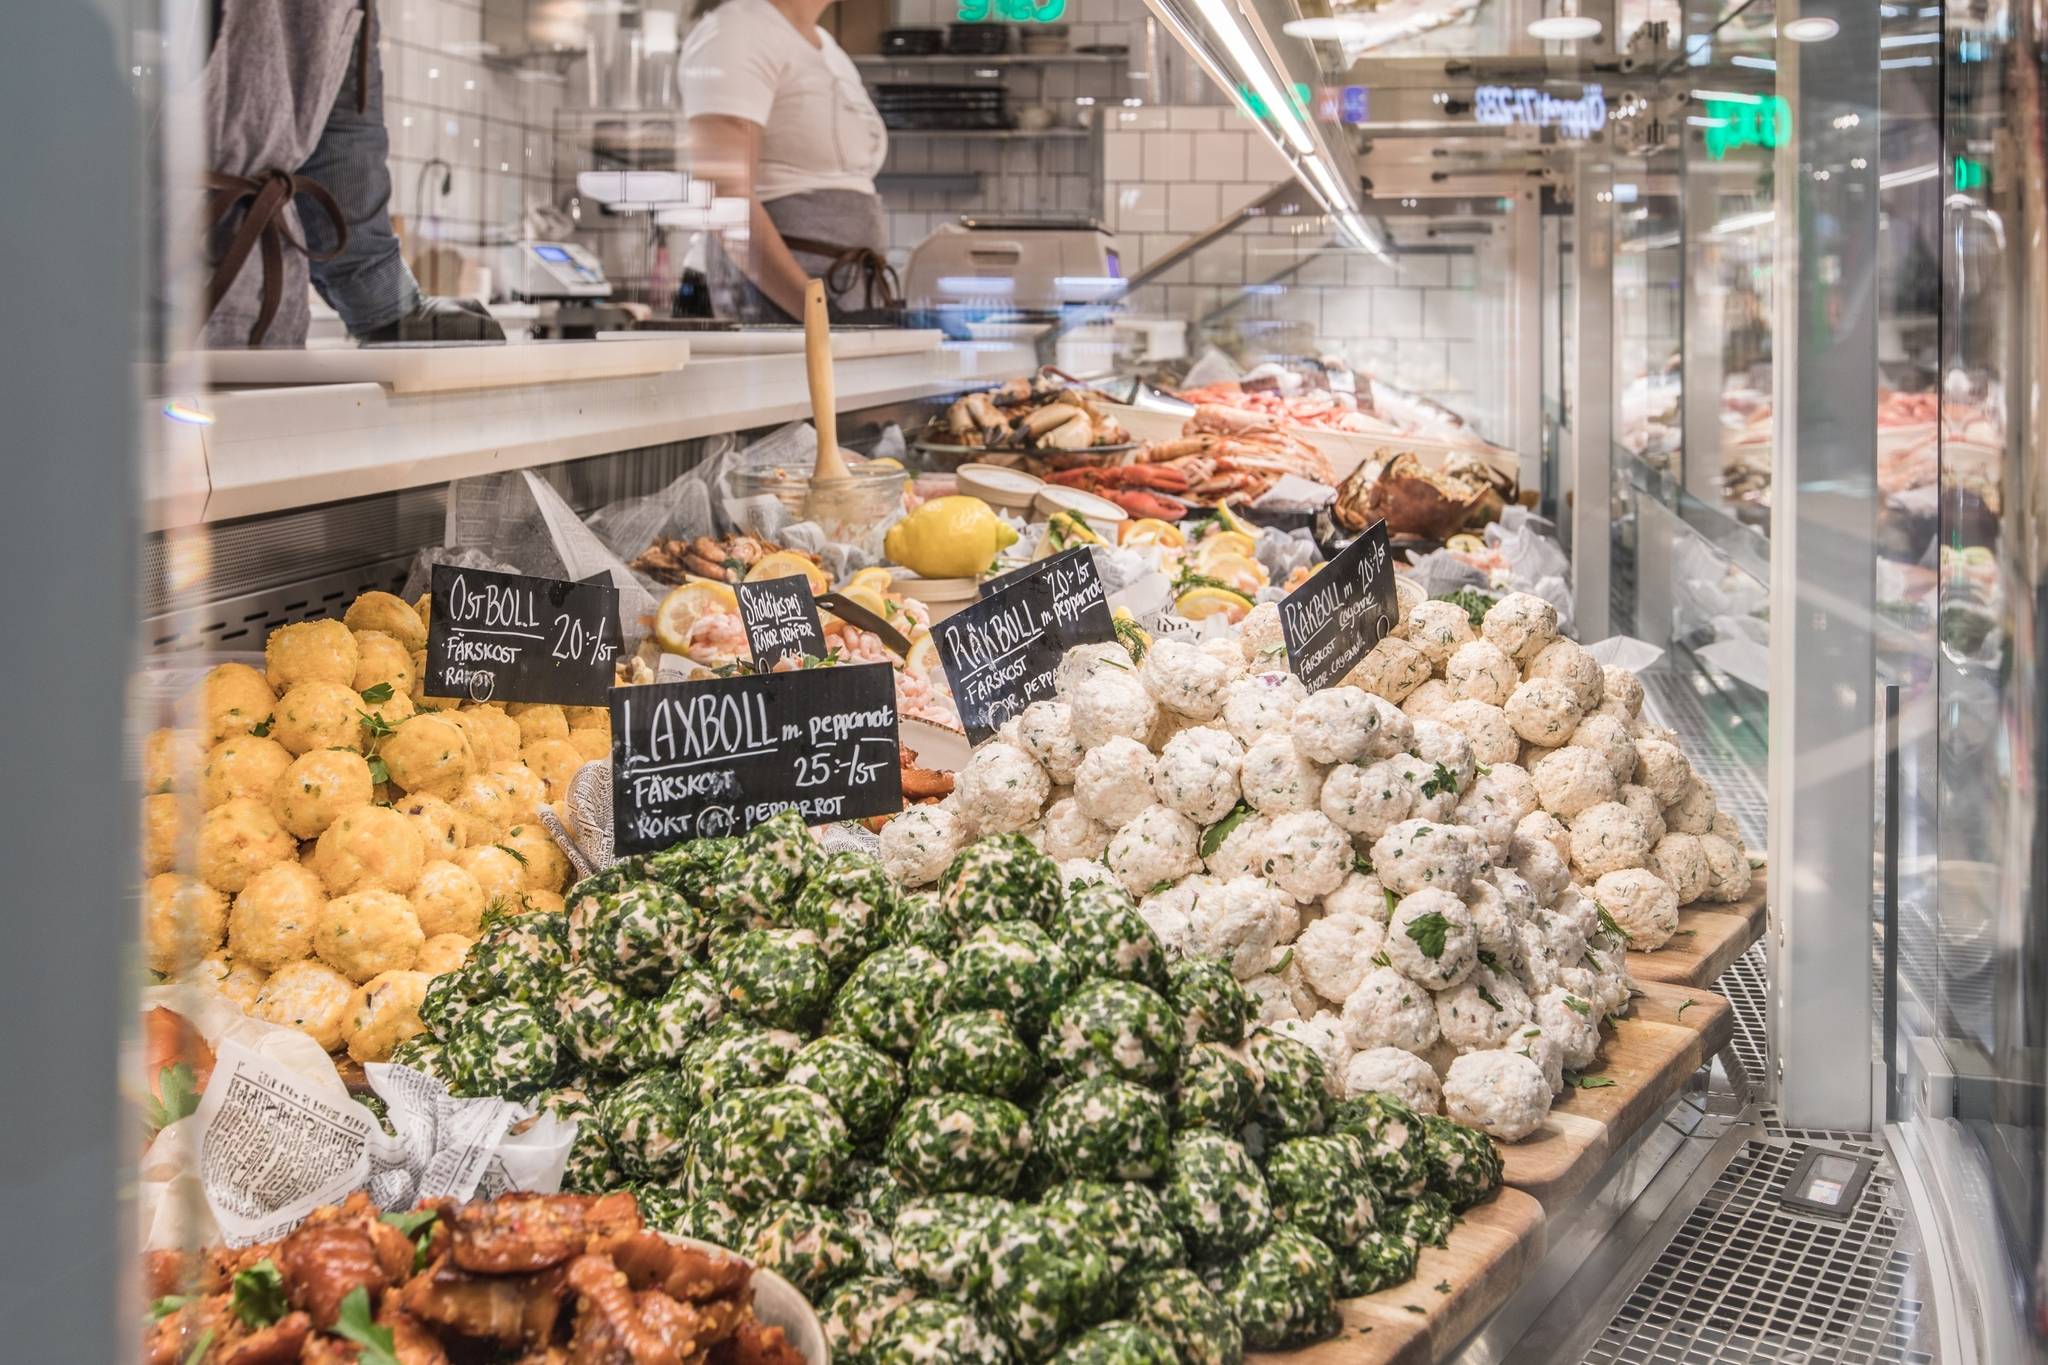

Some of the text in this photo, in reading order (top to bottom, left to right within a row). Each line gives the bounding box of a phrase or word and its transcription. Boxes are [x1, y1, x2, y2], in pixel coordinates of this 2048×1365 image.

[447, 633, 522, 664] FÄRSKOST
[966, 655, 1026, 705] FÄRSKOST
[624, 691, 778, 763] LAXBOLL
